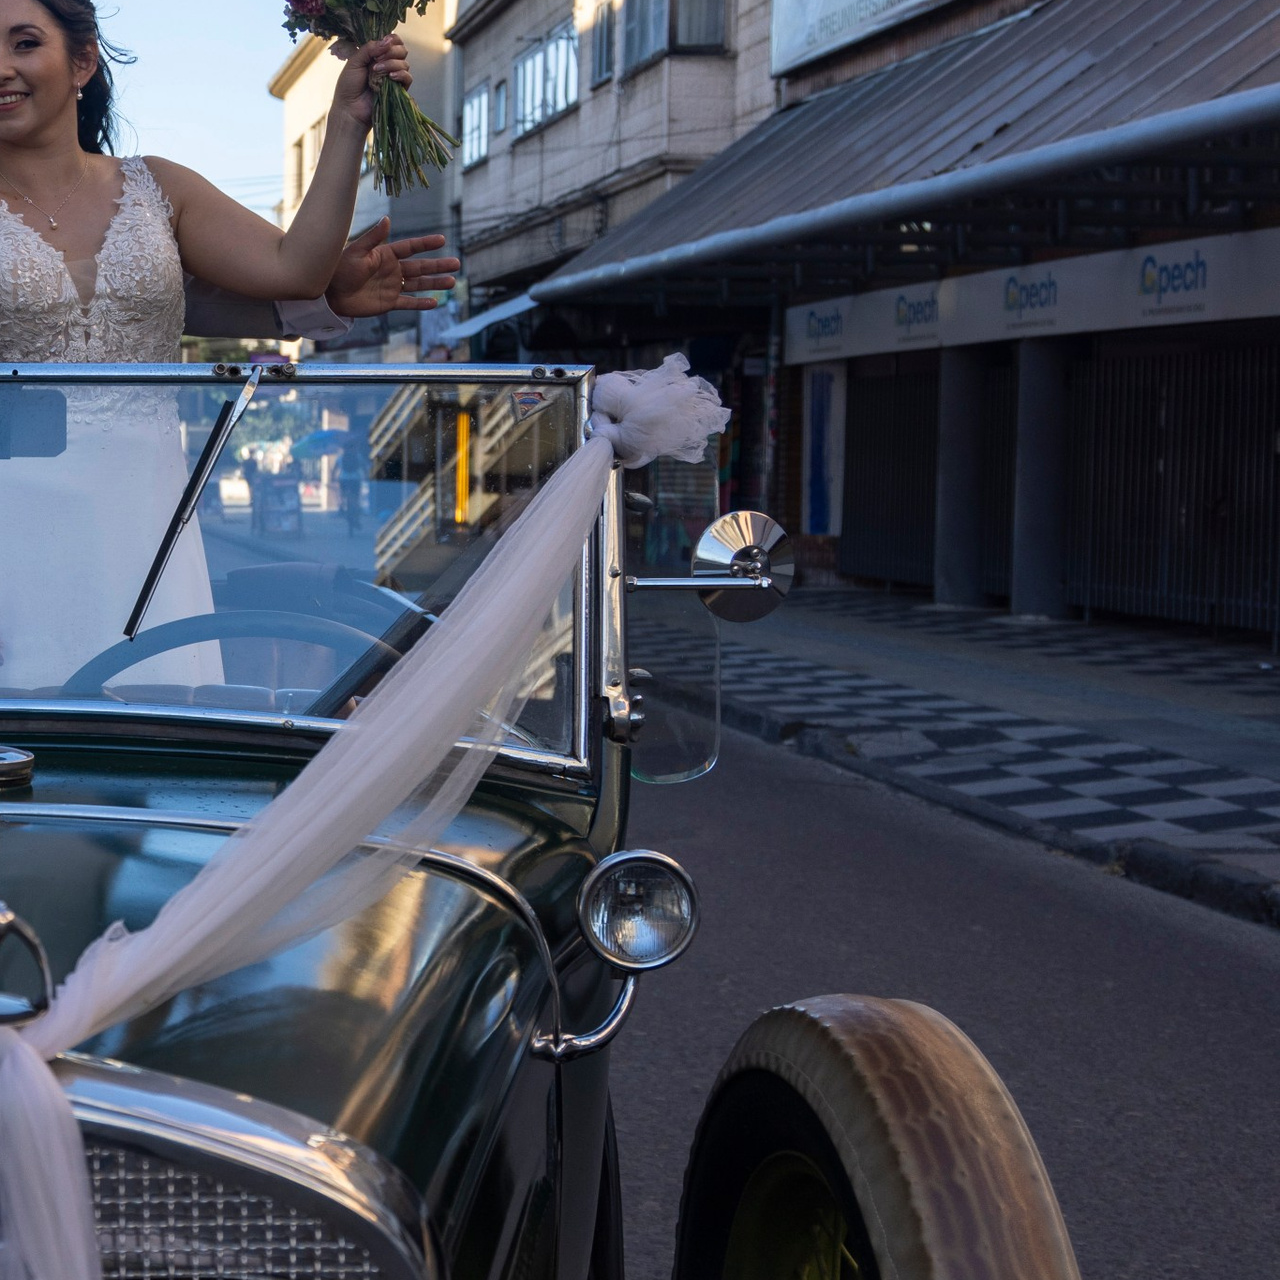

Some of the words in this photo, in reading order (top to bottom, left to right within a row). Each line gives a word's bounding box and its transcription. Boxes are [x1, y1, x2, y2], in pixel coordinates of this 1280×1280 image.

[1003, 272, 1057, 318] Cpech
[1138, 249, 1207, 304] Cpech
[895, 290, 938, 332] Cpech
